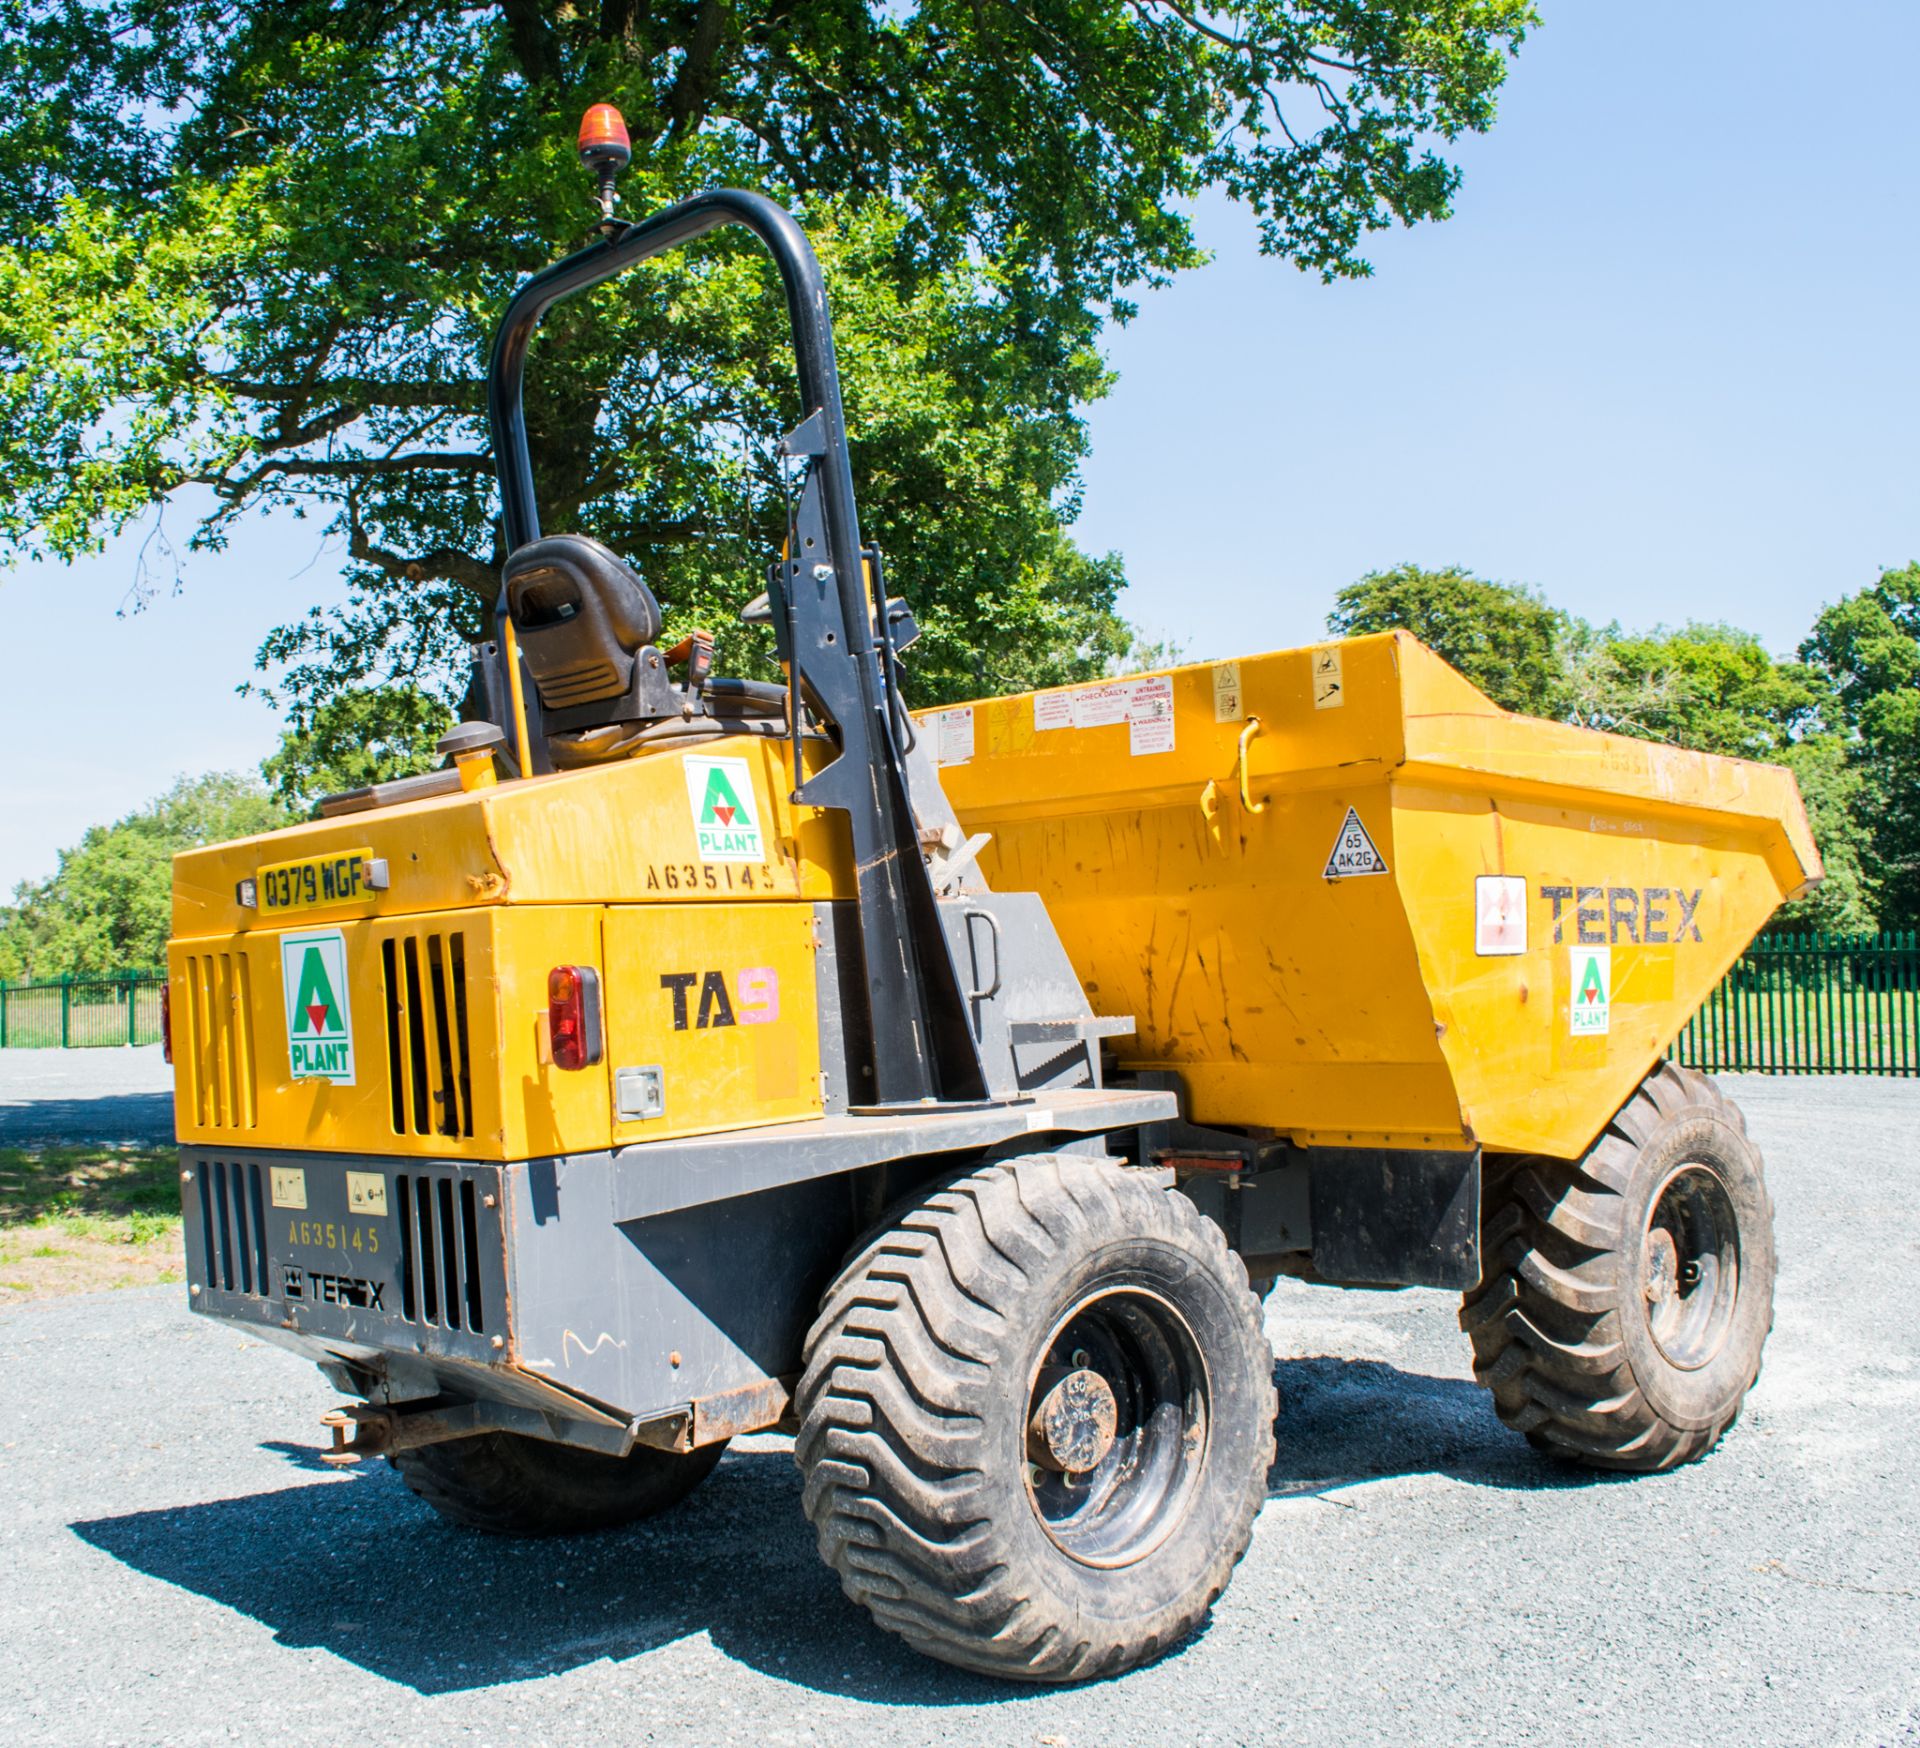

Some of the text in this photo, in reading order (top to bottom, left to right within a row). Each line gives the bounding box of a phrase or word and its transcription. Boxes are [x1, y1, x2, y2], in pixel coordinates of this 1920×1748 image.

[1080, 688, 1124, 702] CHECK DAILY
[1137, 716, 1167, 726] WARNING
[699, 767, 752, 826] A
[698, 832, 758, 853] PLANT
[1345, 833, 1362, 849] 65
[1338, 851, 1372, 867] AK2G
[265, 856, 362, 906] Q379 WGF
[647, 864, 775, 890] A635145
[1540, 885, 1704, 945] TEREX
[293, 947, 345, 1033] A
[1576, 957, 1606, 1005] A
[660, 967, 779, 1032] TA9
[1573, 1010, 1607, 1028] PLANT
[292, 1042, 349, 1072] PLANT
[288, 1221, 380, 1253] A635145
